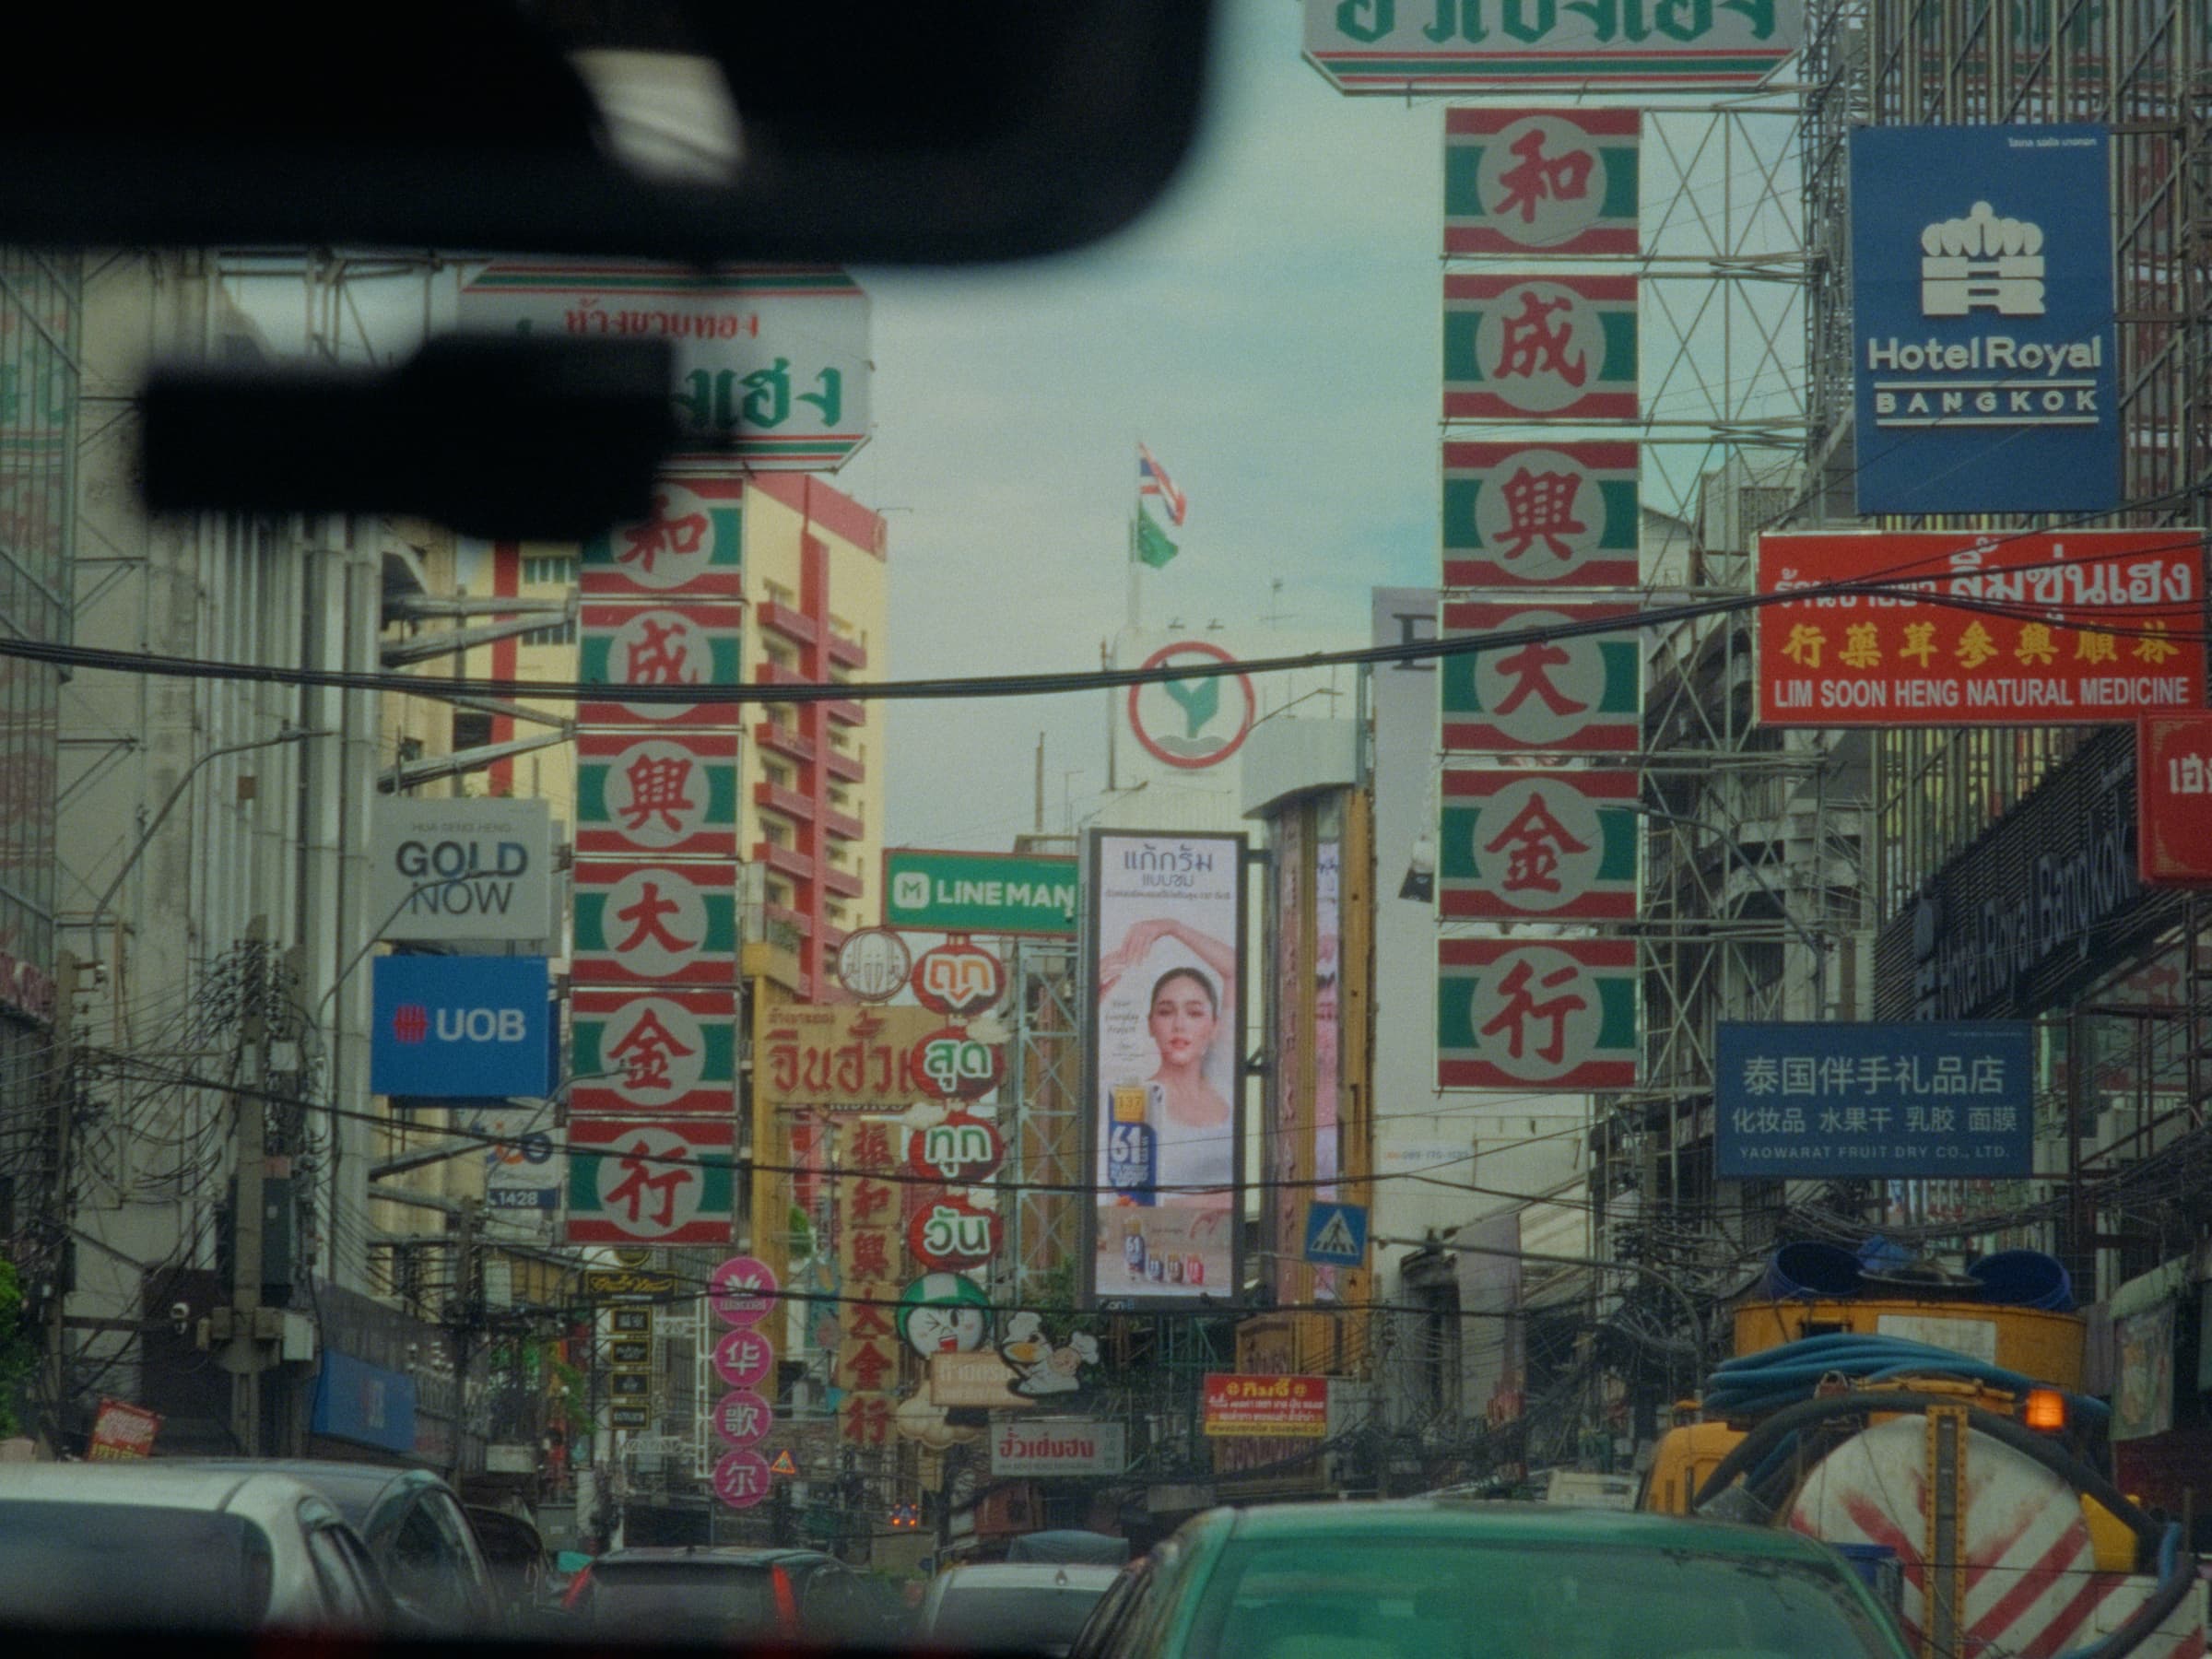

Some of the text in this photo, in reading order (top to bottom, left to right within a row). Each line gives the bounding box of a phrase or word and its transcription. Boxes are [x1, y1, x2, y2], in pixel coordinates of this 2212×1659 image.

[1868, 335, 2101, 376] Hotel Royal
[1876, 390, 2098, 414] BANGKOK
[1775, 677, 2189, 707] LIM SOON HENG NATURAL MEDICINE
[395, 841, 528, 877] GOLD
[411, 882, 514, 913] NOW
[936, 879, 1003, 906] LINE
[1006, 882, 1075, 908] MAN
[437, 1008, 525, 1041] UOB
[1742, 1055, 2005, 1097] 泰国伴手礼品店
[1732, 1106, 2017, 1134] 化妆品 水果干 乳胶 面膜
[1111, 1126, 1141, 1164] 61
[1740, 1146, 2009, 1160] YAOWARAT FRUIT DRY CO., LTD.
[499, 1191, 538, 1206] 1428
[924, 1206, 991, 1253] วัน
[724, 1341, 762, 1497] 华歌尔
